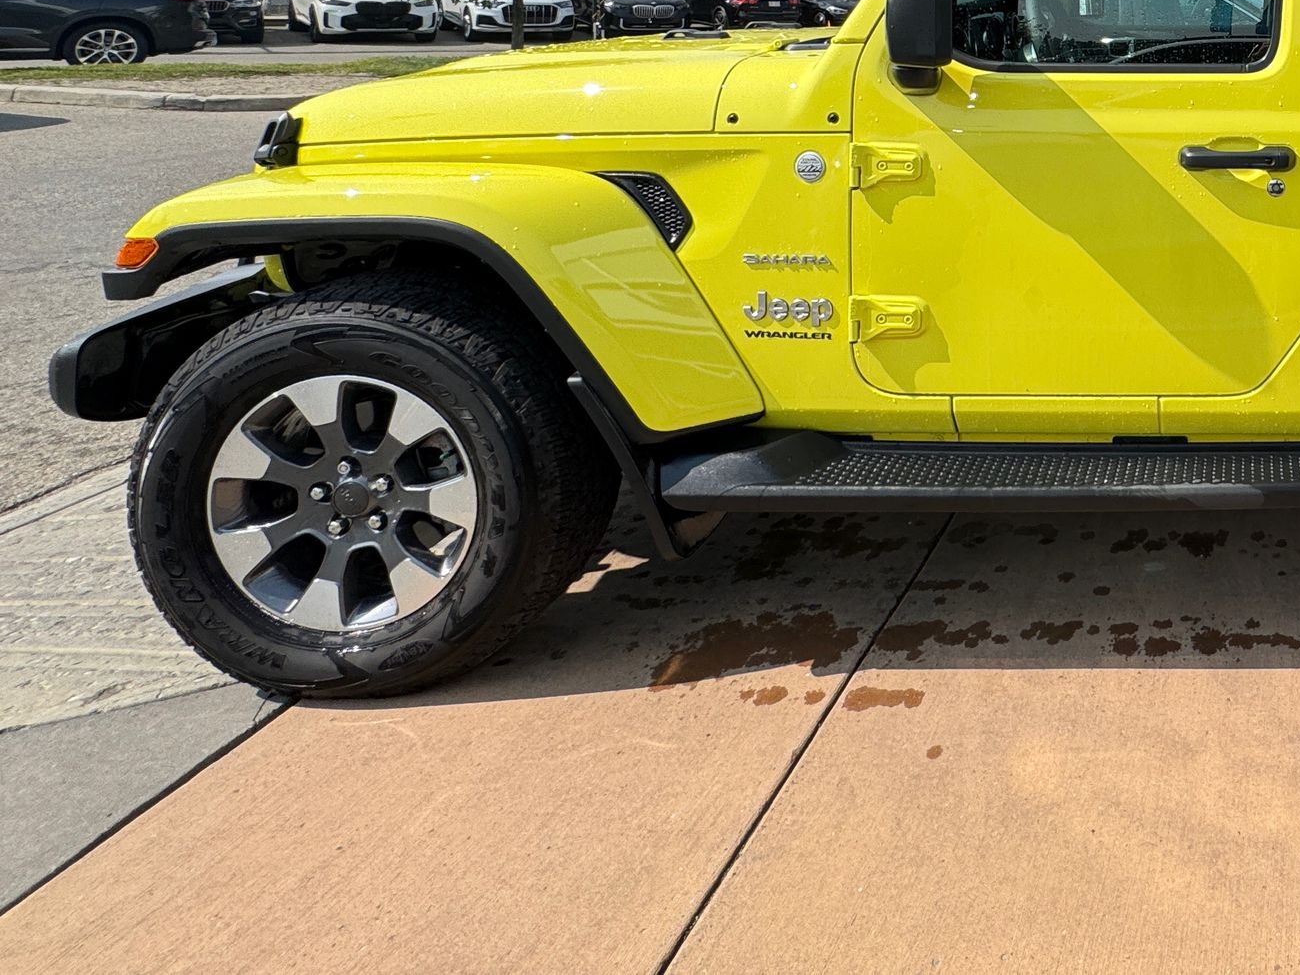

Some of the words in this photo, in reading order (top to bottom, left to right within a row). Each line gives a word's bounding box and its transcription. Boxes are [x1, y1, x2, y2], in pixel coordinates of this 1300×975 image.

[742, 253, 833, 266] SAHARA
[743, 290, 834, 327] Jeep
[744, 329, 832, 340] WRANGLER
[368, 350, 507, 579] GOODYEAR
